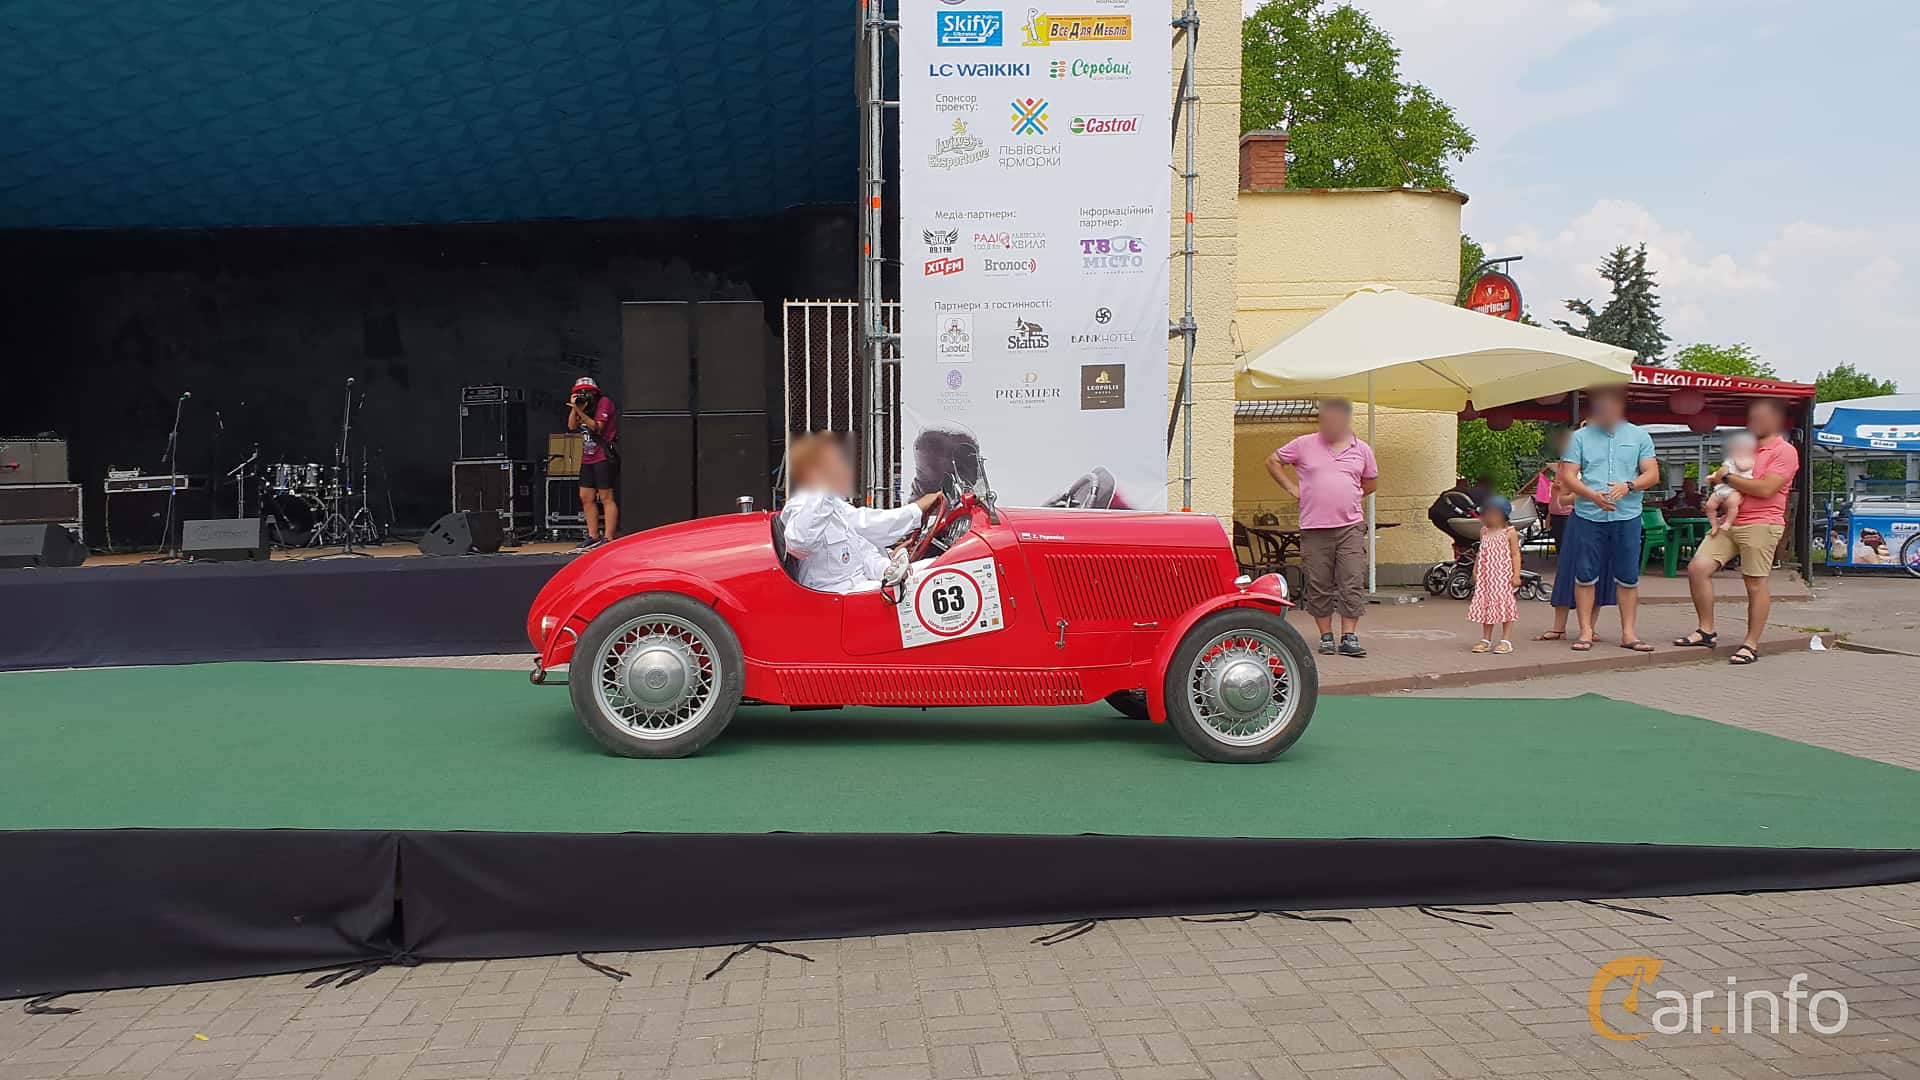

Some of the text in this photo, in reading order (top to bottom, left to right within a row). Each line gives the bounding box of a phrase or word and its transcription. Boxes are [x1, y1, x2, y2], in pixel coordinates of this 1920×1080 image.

[943, 15, 992, 36] Skify
[929, 63, 953, 77] LC
[1071, 57, 1130, 78] Соробан
[936, 93, 977, 104] Спонсор
[935, 103, 979, 112] проекту:
[1086, 117, 1137, 133] Castrol
[934, 210, 1017, 220] Медіа-партнери:
[1079, 204, 1154, 217] Інформаційний
[1079, 219, 1122, 229] партнер:
[1011, 240, 1046, 249] ХВИЛЯ
[983, 259, 1028, 271] Вголос
[1082, 255, 1143, 268] МІСТО
[934, 301, 981, 312] Партнери
[991, 299, 1052, 310] гостинності:
[995, 388, 1061, 400] PREMIER
[932, 585, 965, 614] 63
